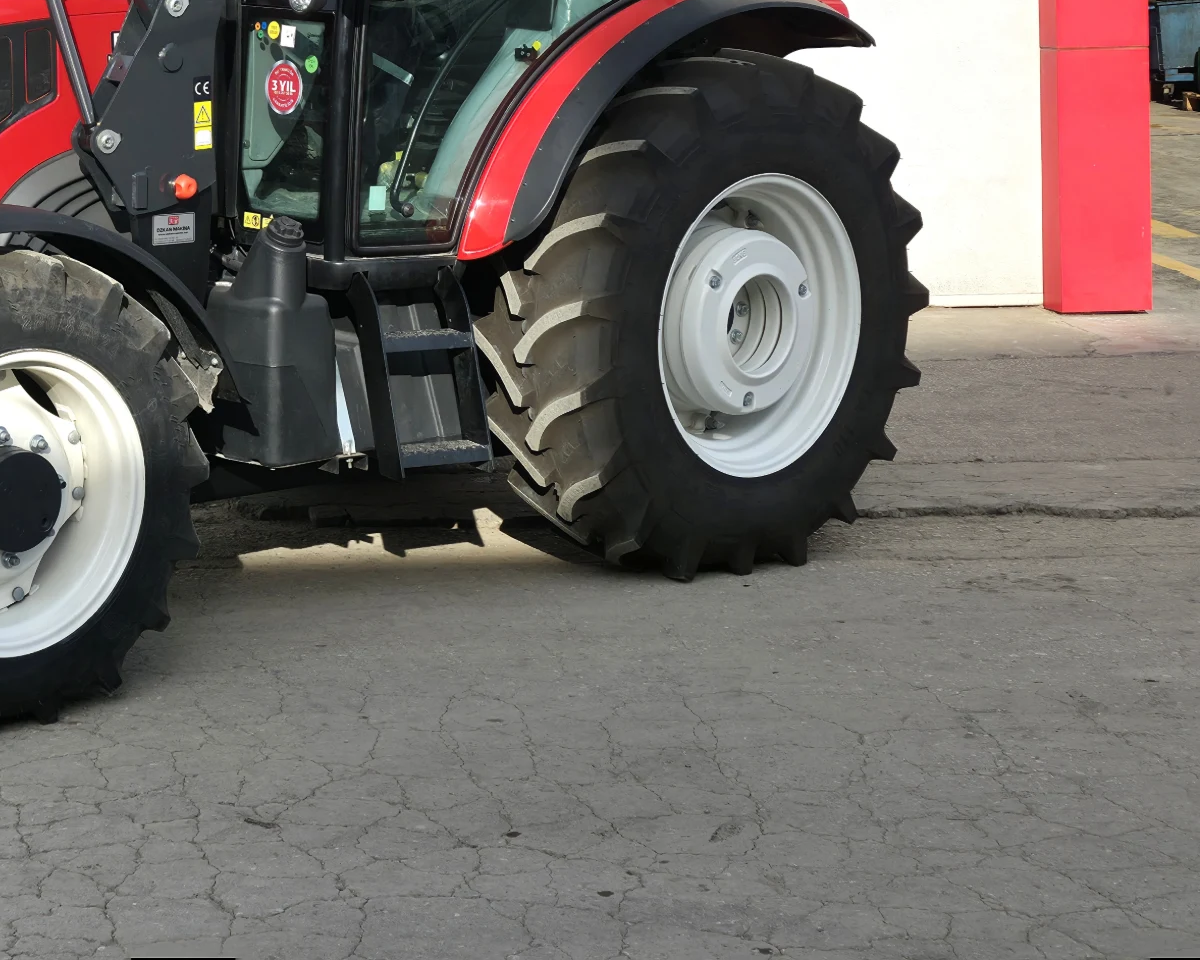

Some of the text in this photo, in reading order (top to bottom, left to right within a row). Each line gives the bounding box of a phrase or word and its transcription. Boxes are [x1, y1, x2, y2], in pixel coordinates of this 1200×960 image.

[194, 80, 210, 95] CE
[271, 80, 296, 93] 3 YIL
